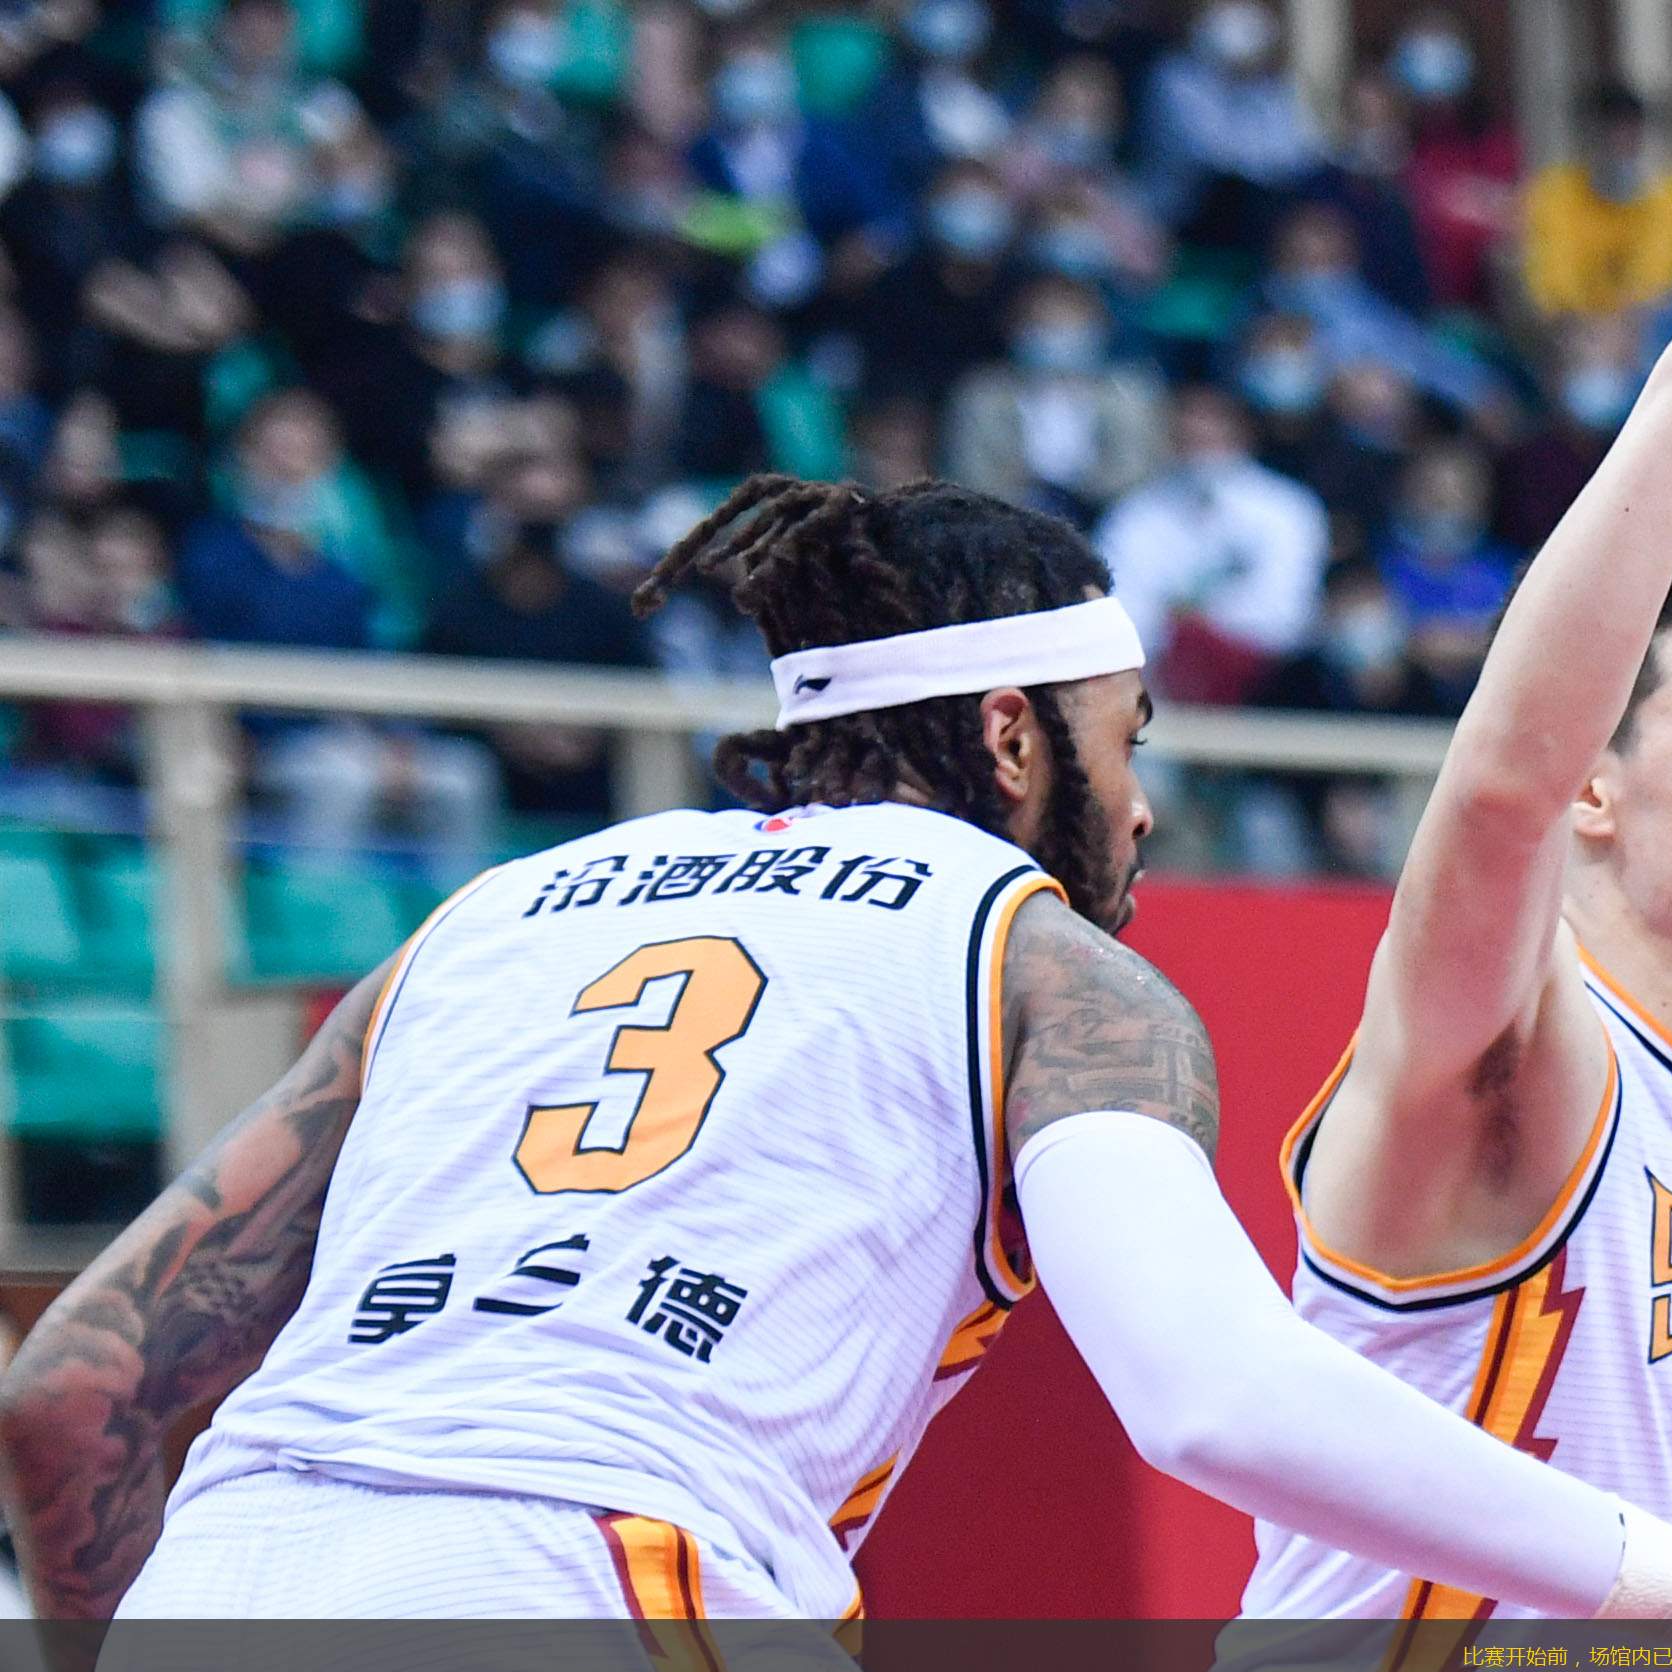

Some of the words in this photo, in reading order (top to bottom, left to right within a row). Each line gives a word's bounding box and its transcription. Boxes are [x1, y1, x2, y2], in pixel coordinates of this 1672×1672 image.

[521, 845, 934, 918] 汾酒股份
[511, 934, 769, 1195] 3
